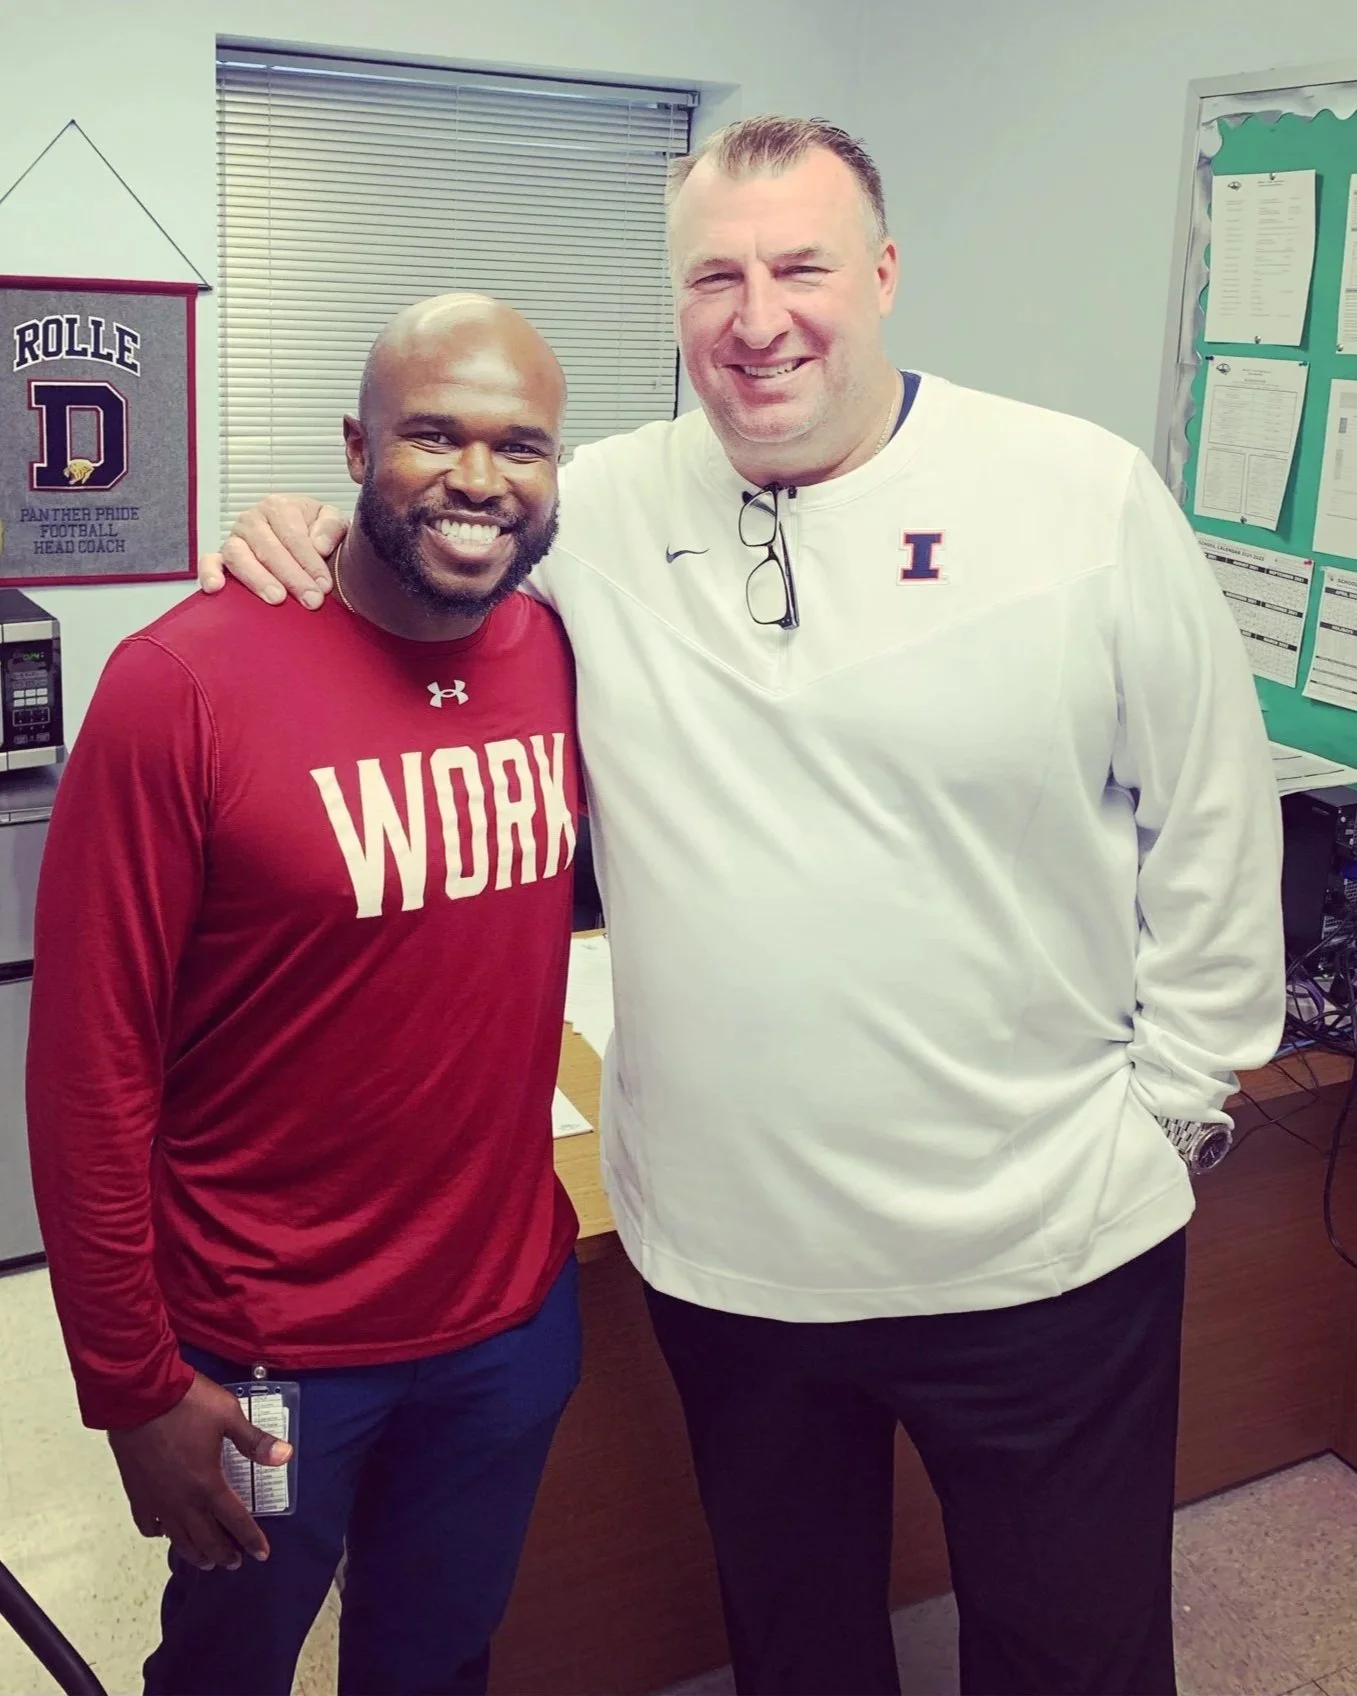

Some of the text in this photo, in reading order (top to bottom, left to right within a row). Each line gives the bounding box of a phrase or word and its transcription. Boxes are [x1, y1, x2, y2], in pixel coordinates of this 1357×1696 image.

[13, 315, 140, 377] ROLLE
[27, 379, 129, 491] D
[20, 507, 139, 522] PANTHER PRIDE
[40, 524, 118, 538] FOOTBALL
[33, 539, 126, 554] HEAD COACH
[900, 528, 945, 582] I
[310, 733, 576, 919] WORK
